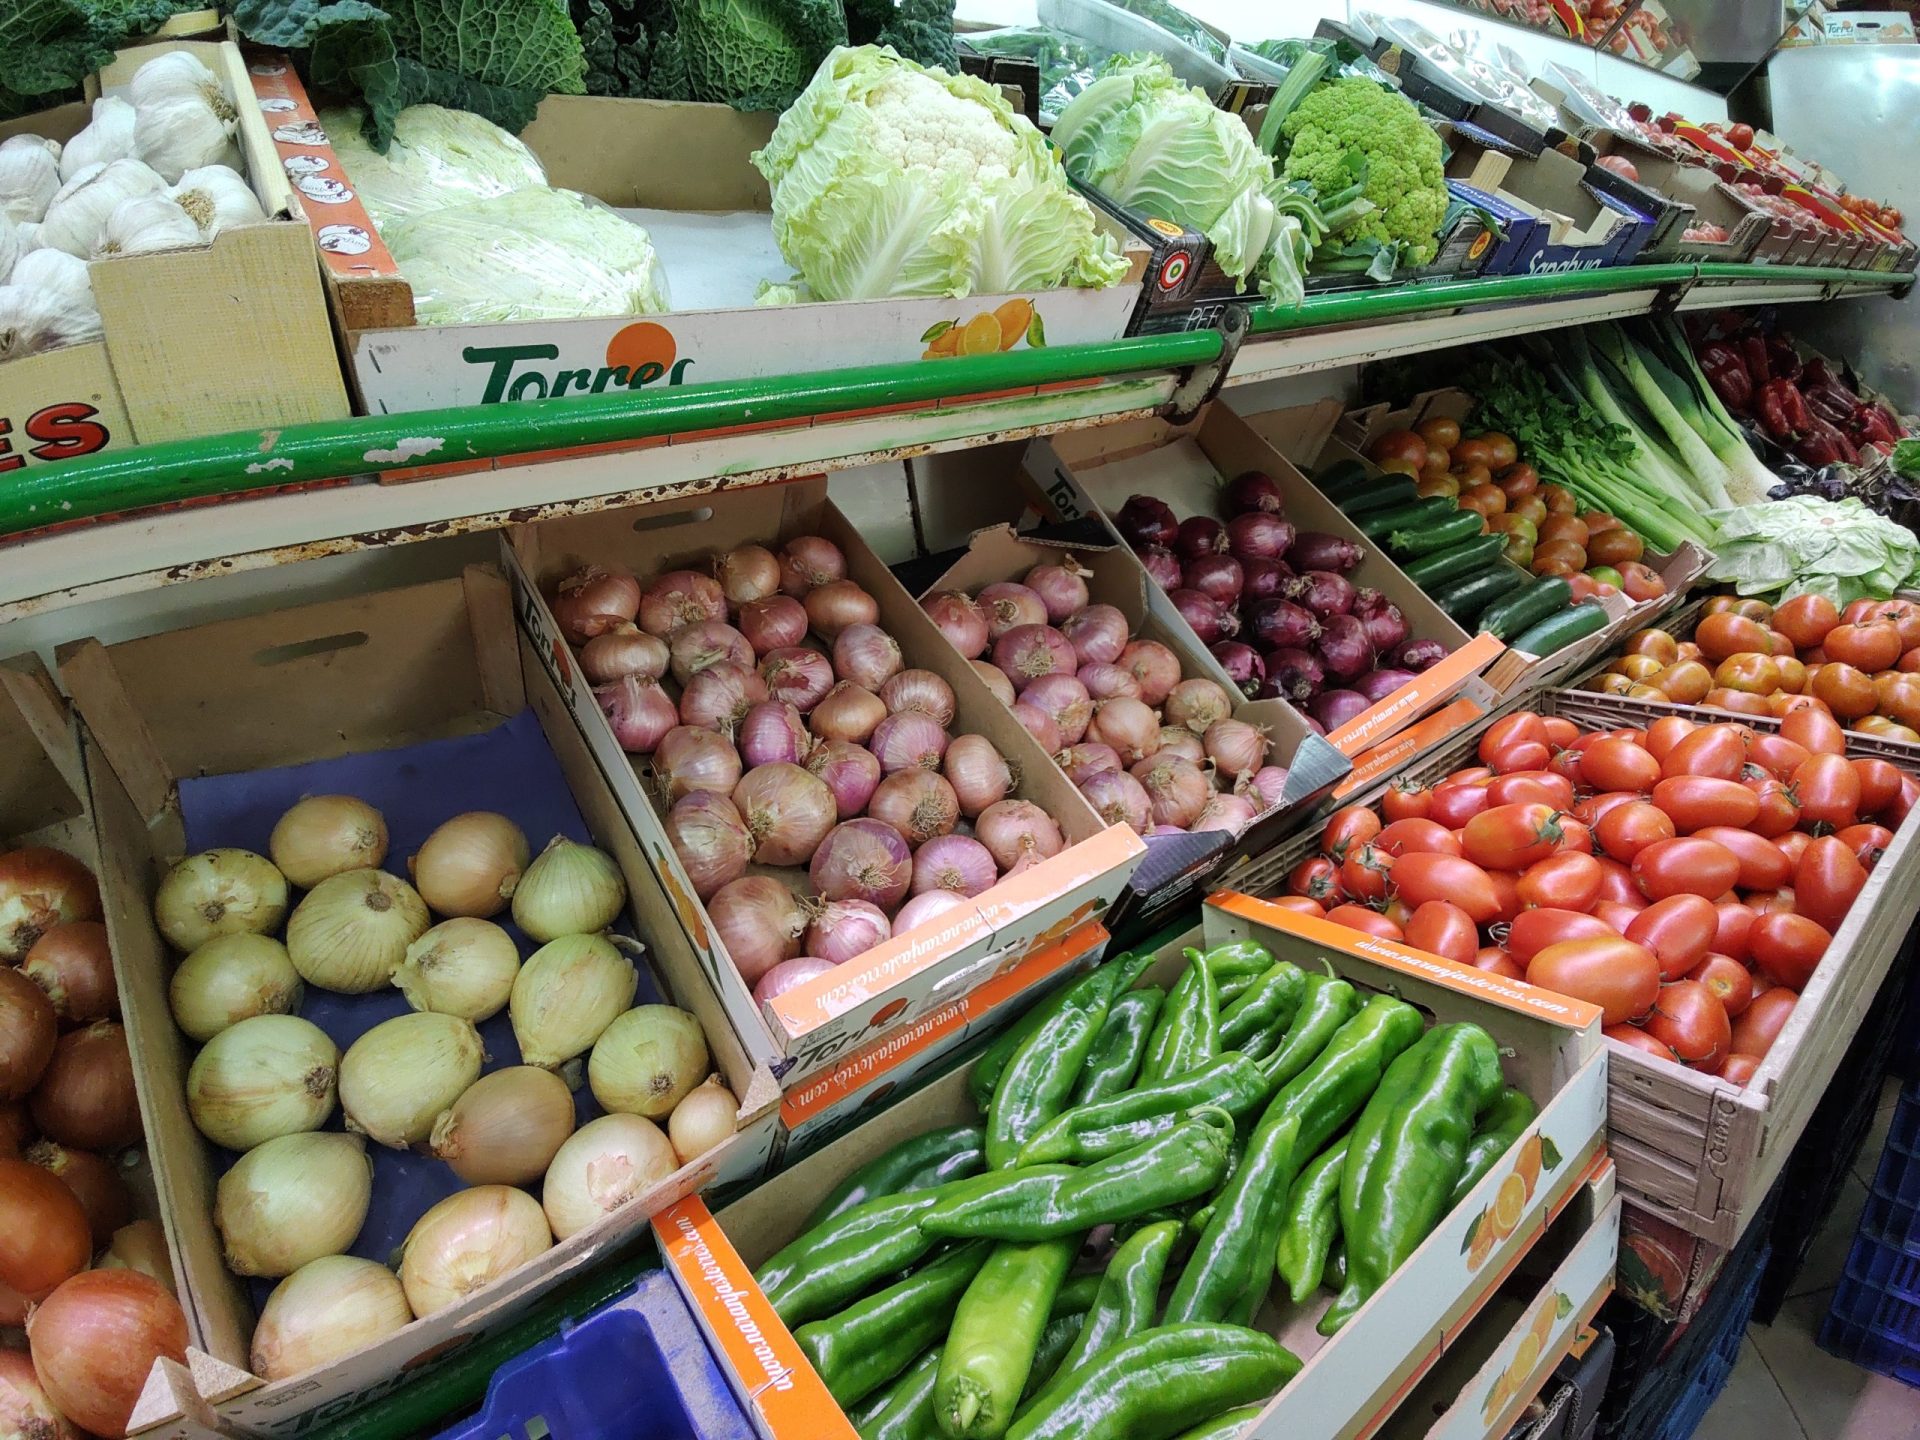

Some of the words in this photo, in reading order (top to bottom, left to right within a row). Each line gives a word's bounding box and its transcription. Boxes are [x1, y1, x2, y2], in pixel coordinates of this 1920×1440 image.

[1045, 467, 1081, 519] Tor
[815, 903, 999, 1010] www.naranjastorres.com
[1354, 940, 1569, 1015] www.naranjastorres.com
[798, 999, 970, 1107] www.naranjastorres.com
[675, 1215, 794, 1392] www.naranjastorres.com
